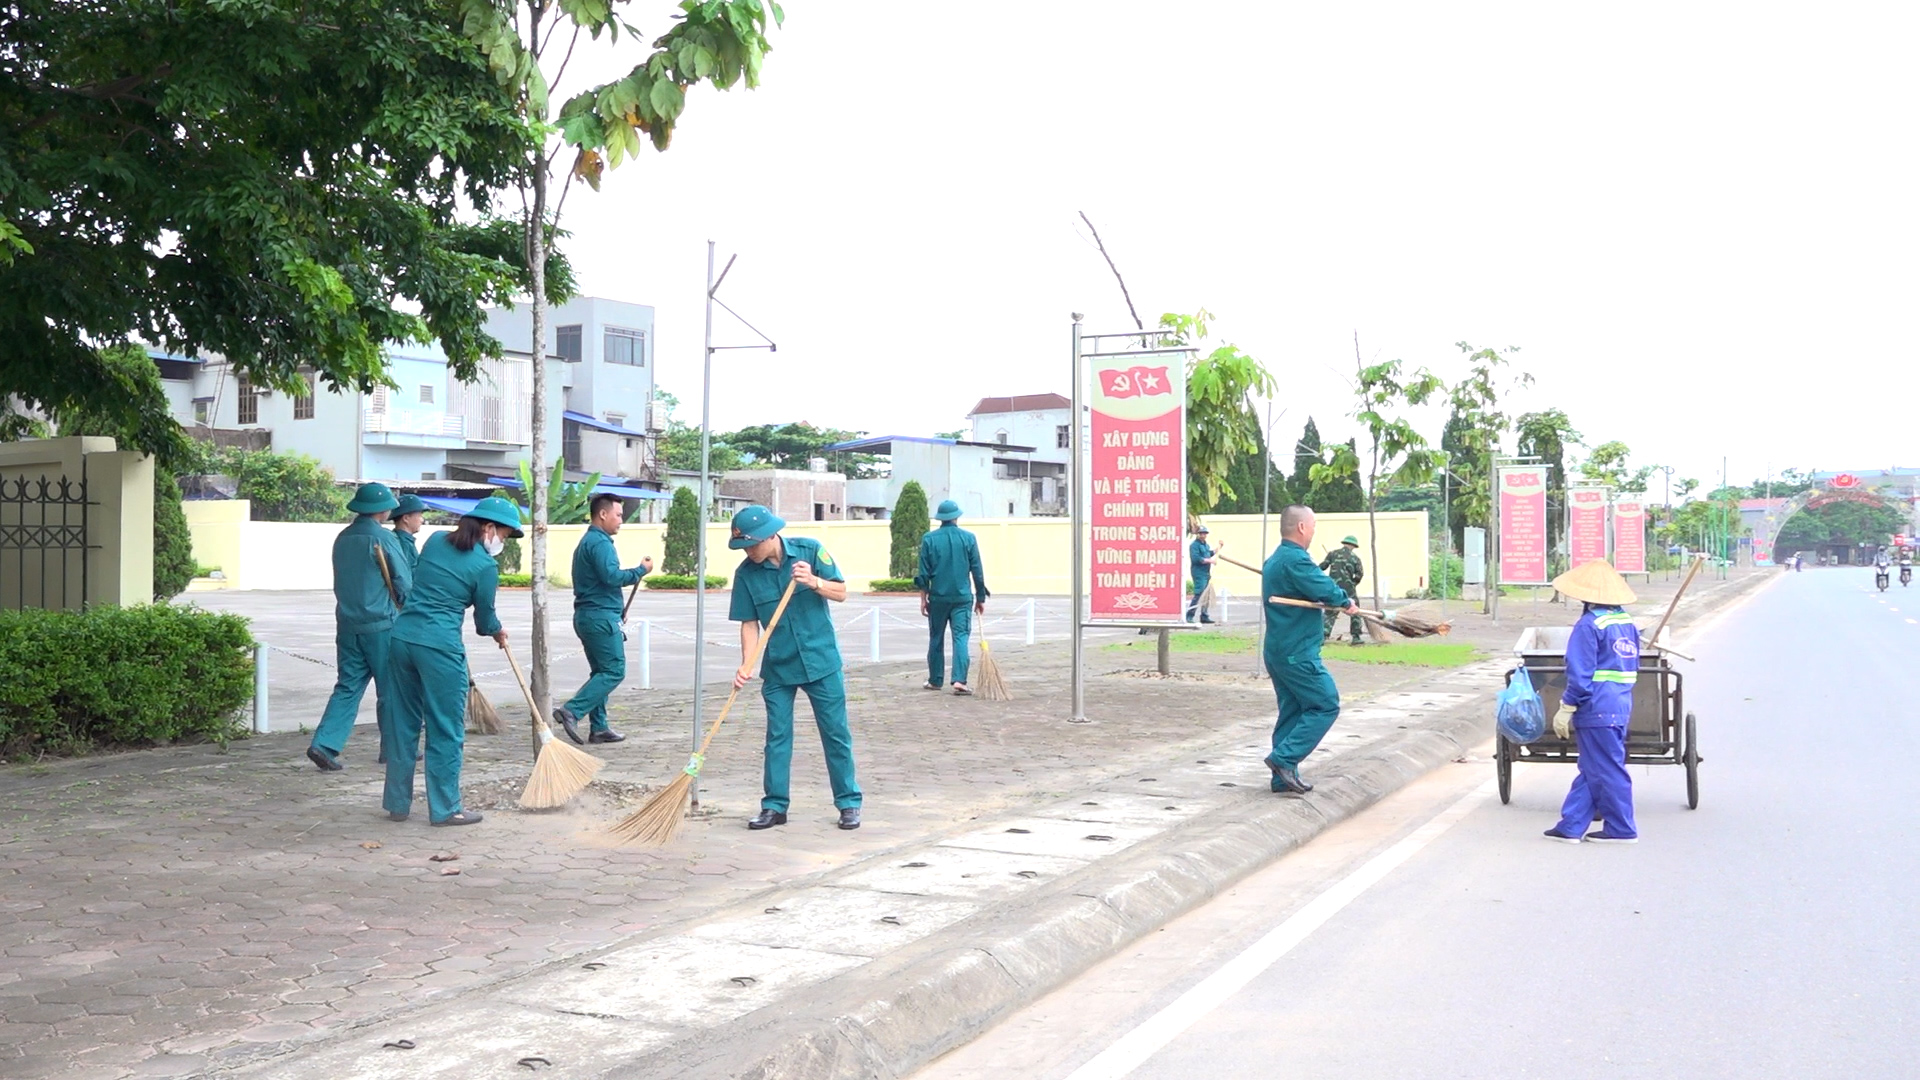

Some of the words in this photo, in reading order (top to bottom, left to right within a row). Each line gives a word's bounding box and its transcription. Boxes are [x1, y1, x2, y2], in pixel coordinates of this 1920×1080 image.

[1103, 430, 1129, 448] XÂY
[1132, 430, 1170, 450] DỰNG
[1117, 451, 1155, 470] ĐẢNG
[1093, 476, 1111, 494] VÀ
[1114, 476, 1131, 497] HỆ
[1135, 473, 1179, 494] THỐNG
[1103, 499, 1144, 518] CHÍNH
[1147, 502, 1169, 520] TRỊ
[1092, 526, 1137, 541] TRONG
[1139, 526, 1180, 544] SẠCH,
[1096, 547, 1132, 565] VỮNG
[1135, 549, 1176, 567] MẠNH
[1096, 570, 1132, 588] TOÀN
[1135, 570, 1166, 591] DIỆN
